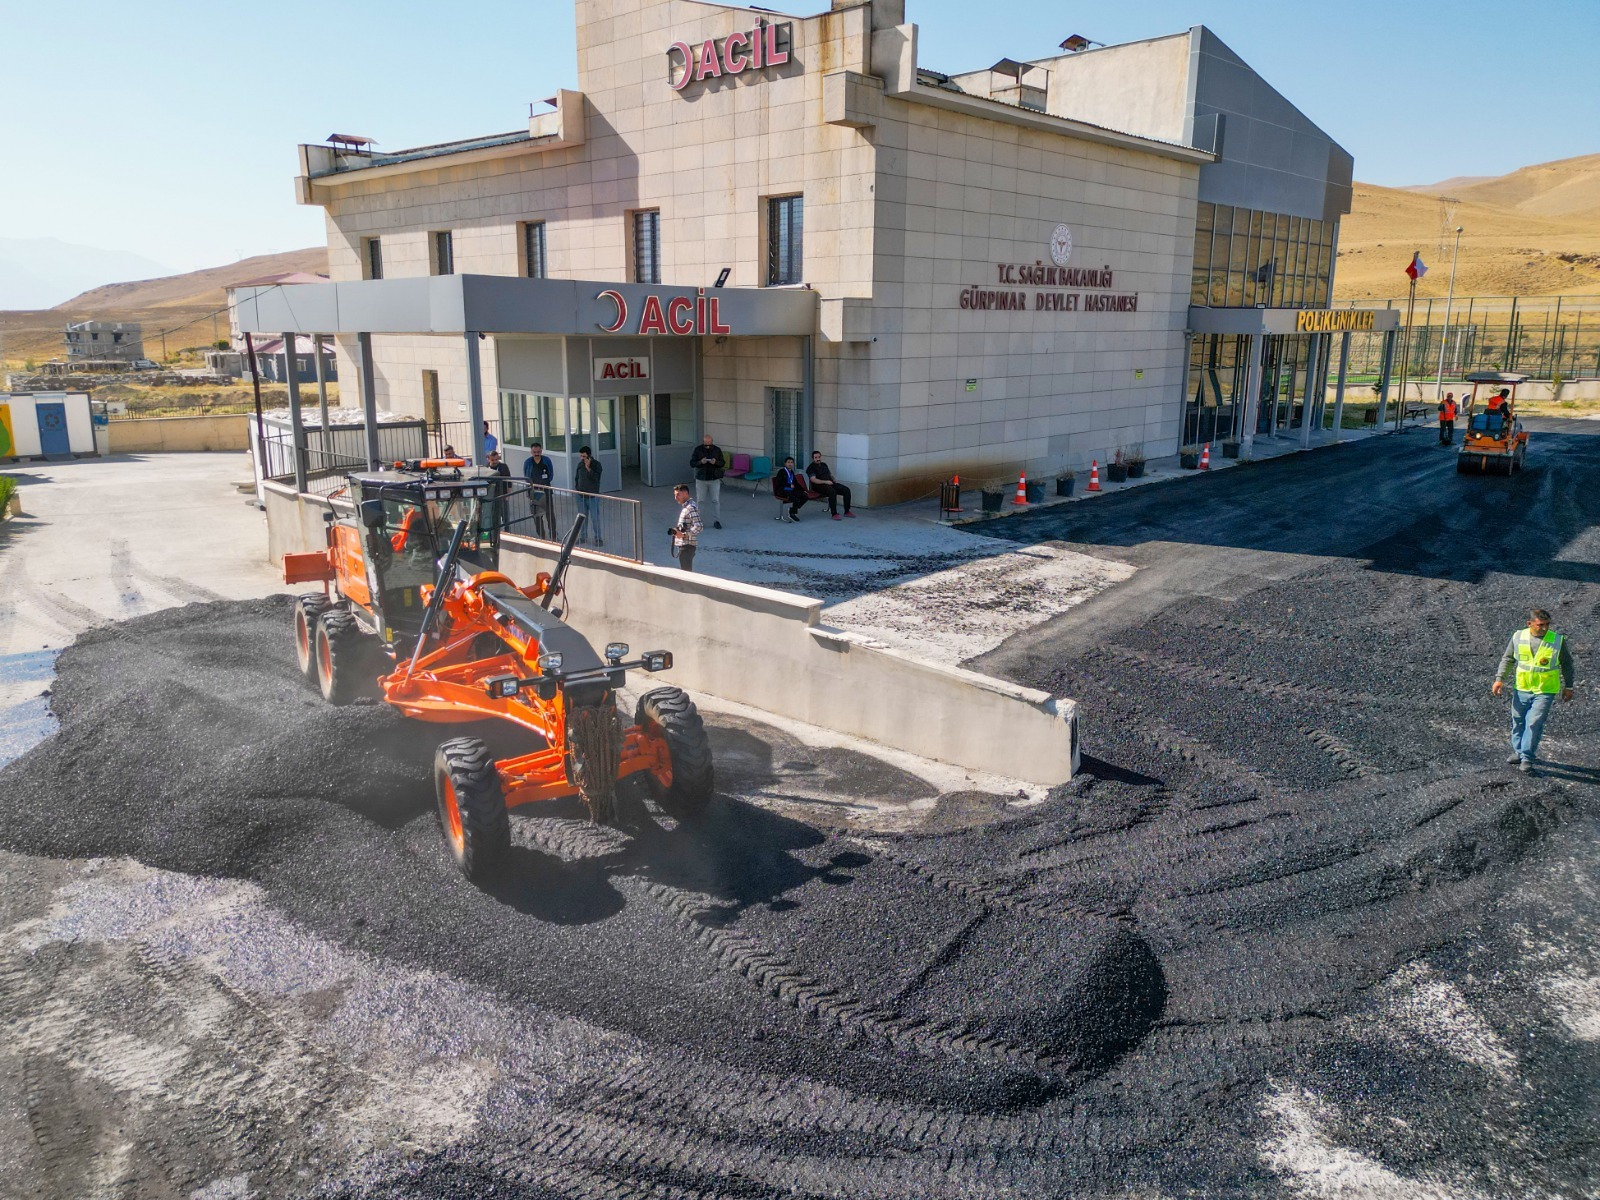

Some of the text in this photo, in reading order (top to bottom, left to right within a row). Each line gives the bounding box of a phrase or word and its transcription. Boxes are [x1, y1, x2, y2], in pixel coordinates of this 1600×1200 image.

[696, 16, 788, 81] ACİL
[998, 260, 1113, 288] T.C. SAĞLIK BAKANLIĞI
[639, 287, 730, 335] ACİL
[960, 285, 1138, 312] GÜRPINAR DEVLET HASTANESİ
[602, 358, 647, 379] ACİL
